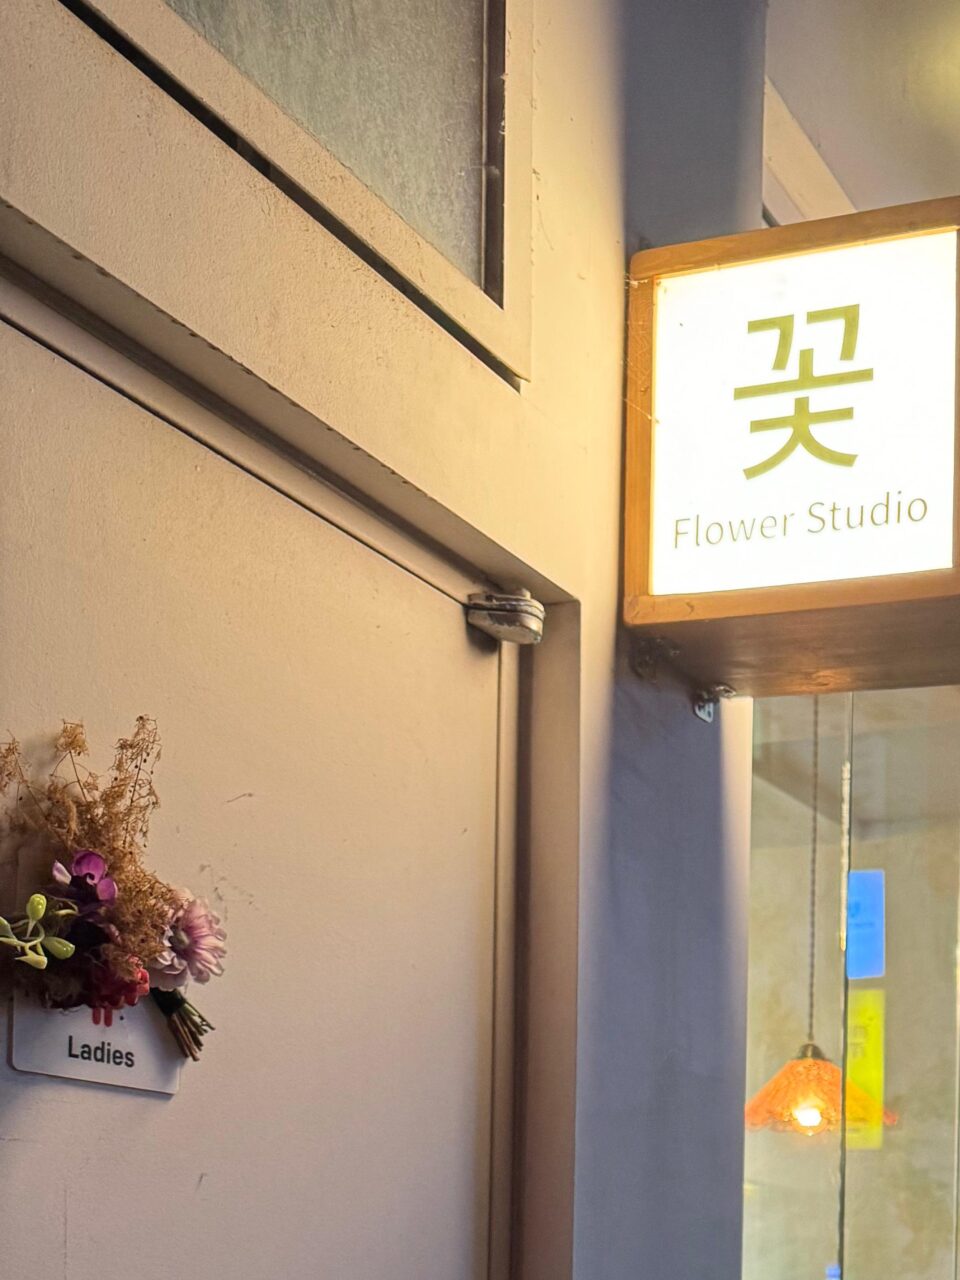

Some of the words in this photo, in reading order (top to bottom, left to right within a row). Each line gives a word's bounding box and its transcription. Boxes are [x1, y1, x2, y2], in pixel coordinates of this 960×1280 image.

[733, 303, 874, 480] 꽃
[673, 511, 796, 549] Flower
[806, 489, 928, 534] Studio
[67, 1035, 135, 1068] Ladies
